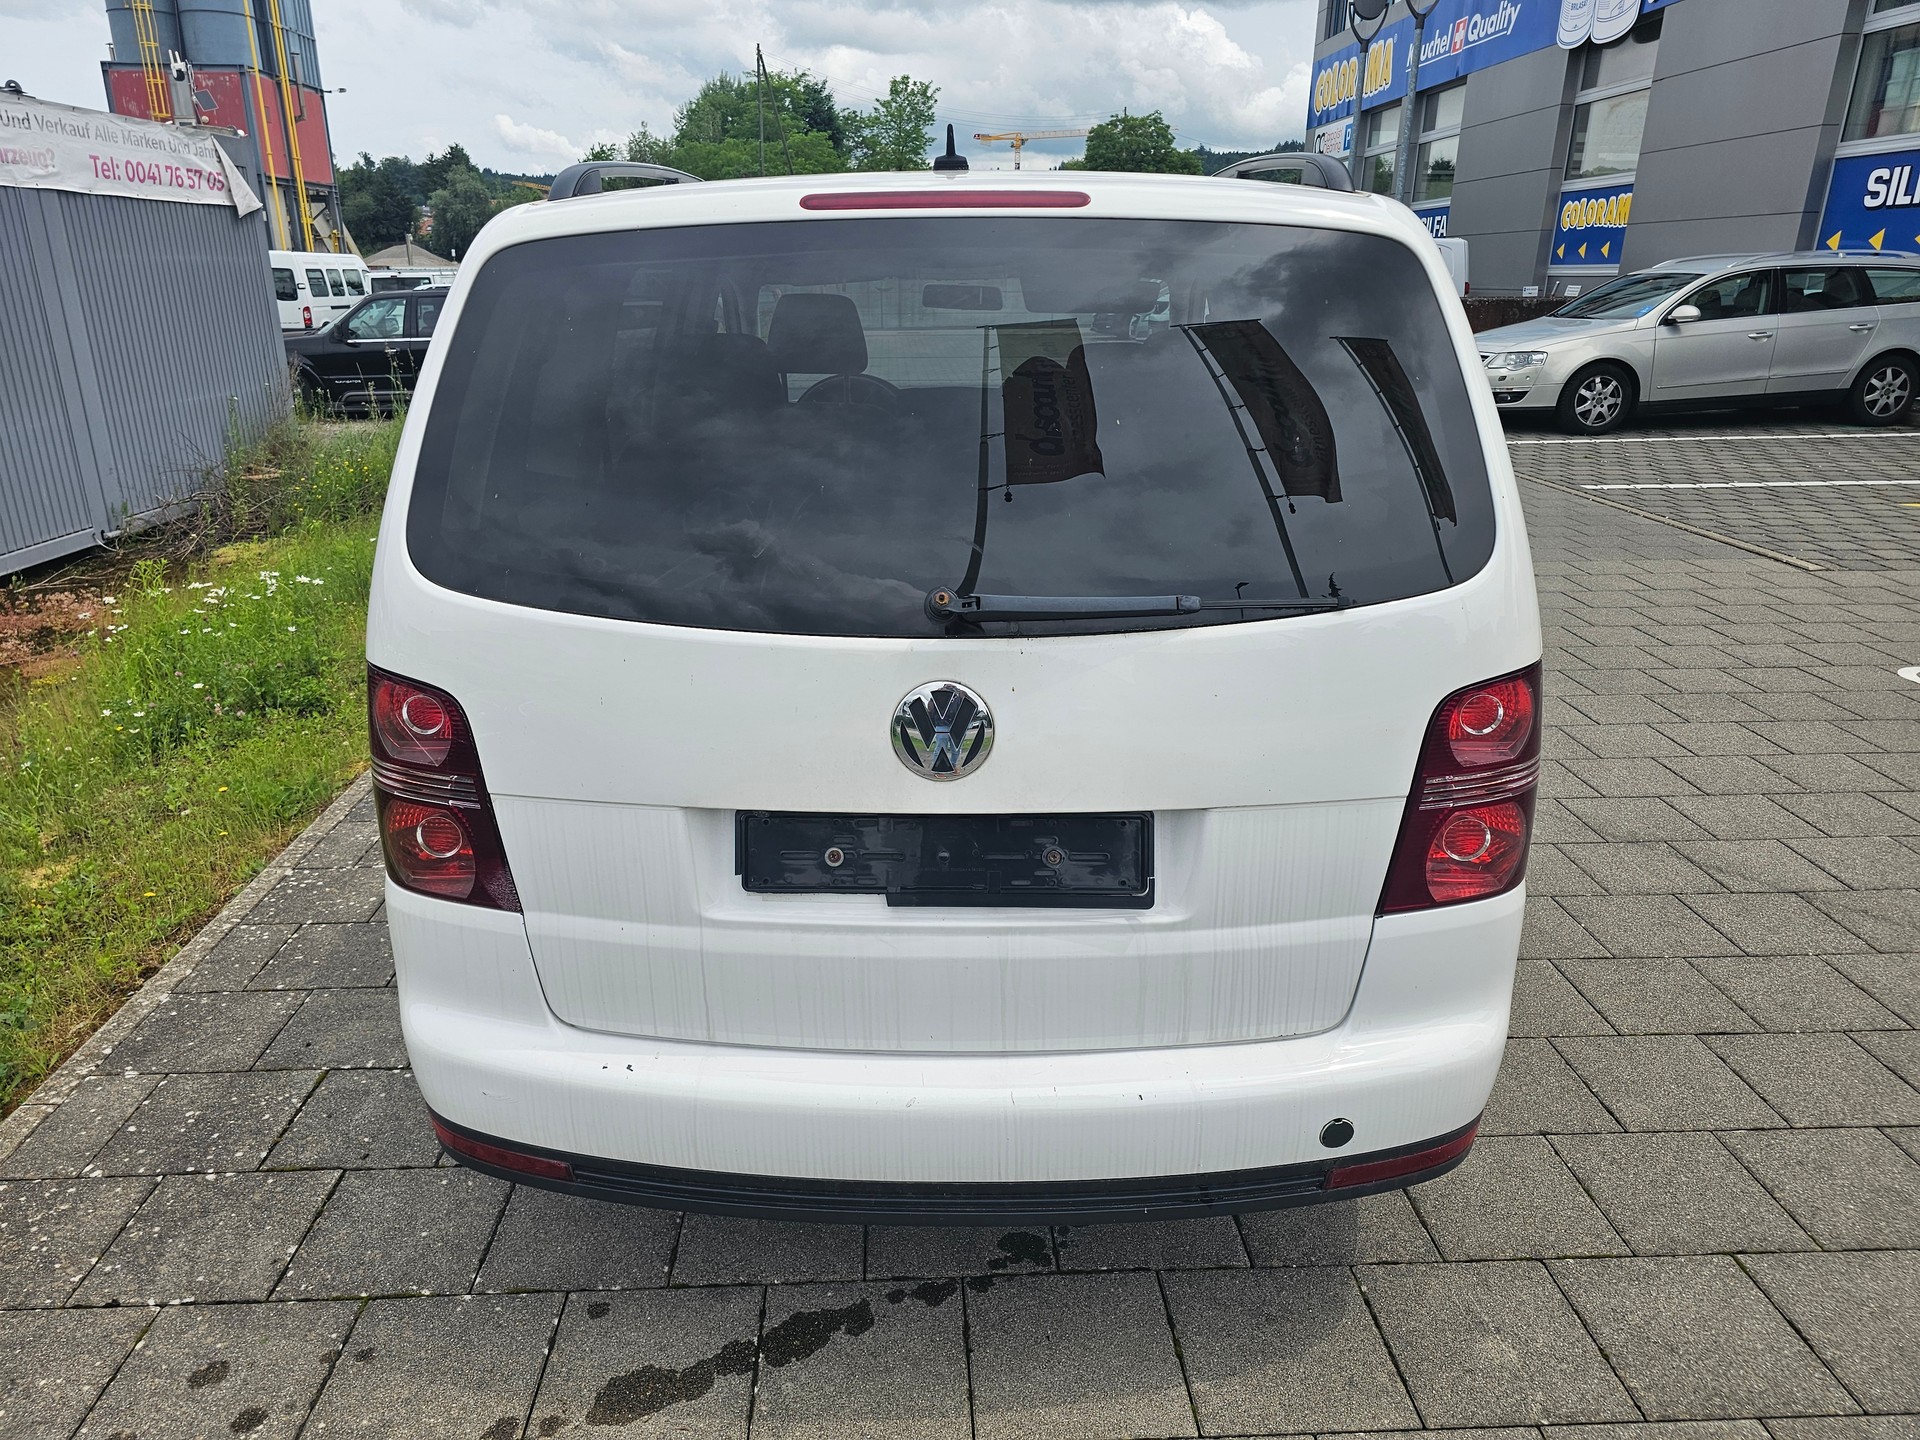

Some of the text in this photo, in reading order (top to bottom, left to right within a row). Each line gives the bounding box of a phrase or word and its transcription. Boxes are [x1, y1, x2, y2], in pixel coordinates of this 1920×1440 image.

[1467, 0, 1521, 42] Quality
[1314, 38, 1393, 116] COLORMA
[33, 113, 91, 139] Verkauf
[95, 125, 119, 144] Alle
[121, 129, 166, 151] Marken
[168, 138, 191, 154] Und
[88, 154, 225, 191] Tel: 0041 76 57 05
[1863, 165, 1920, 208] SIL
